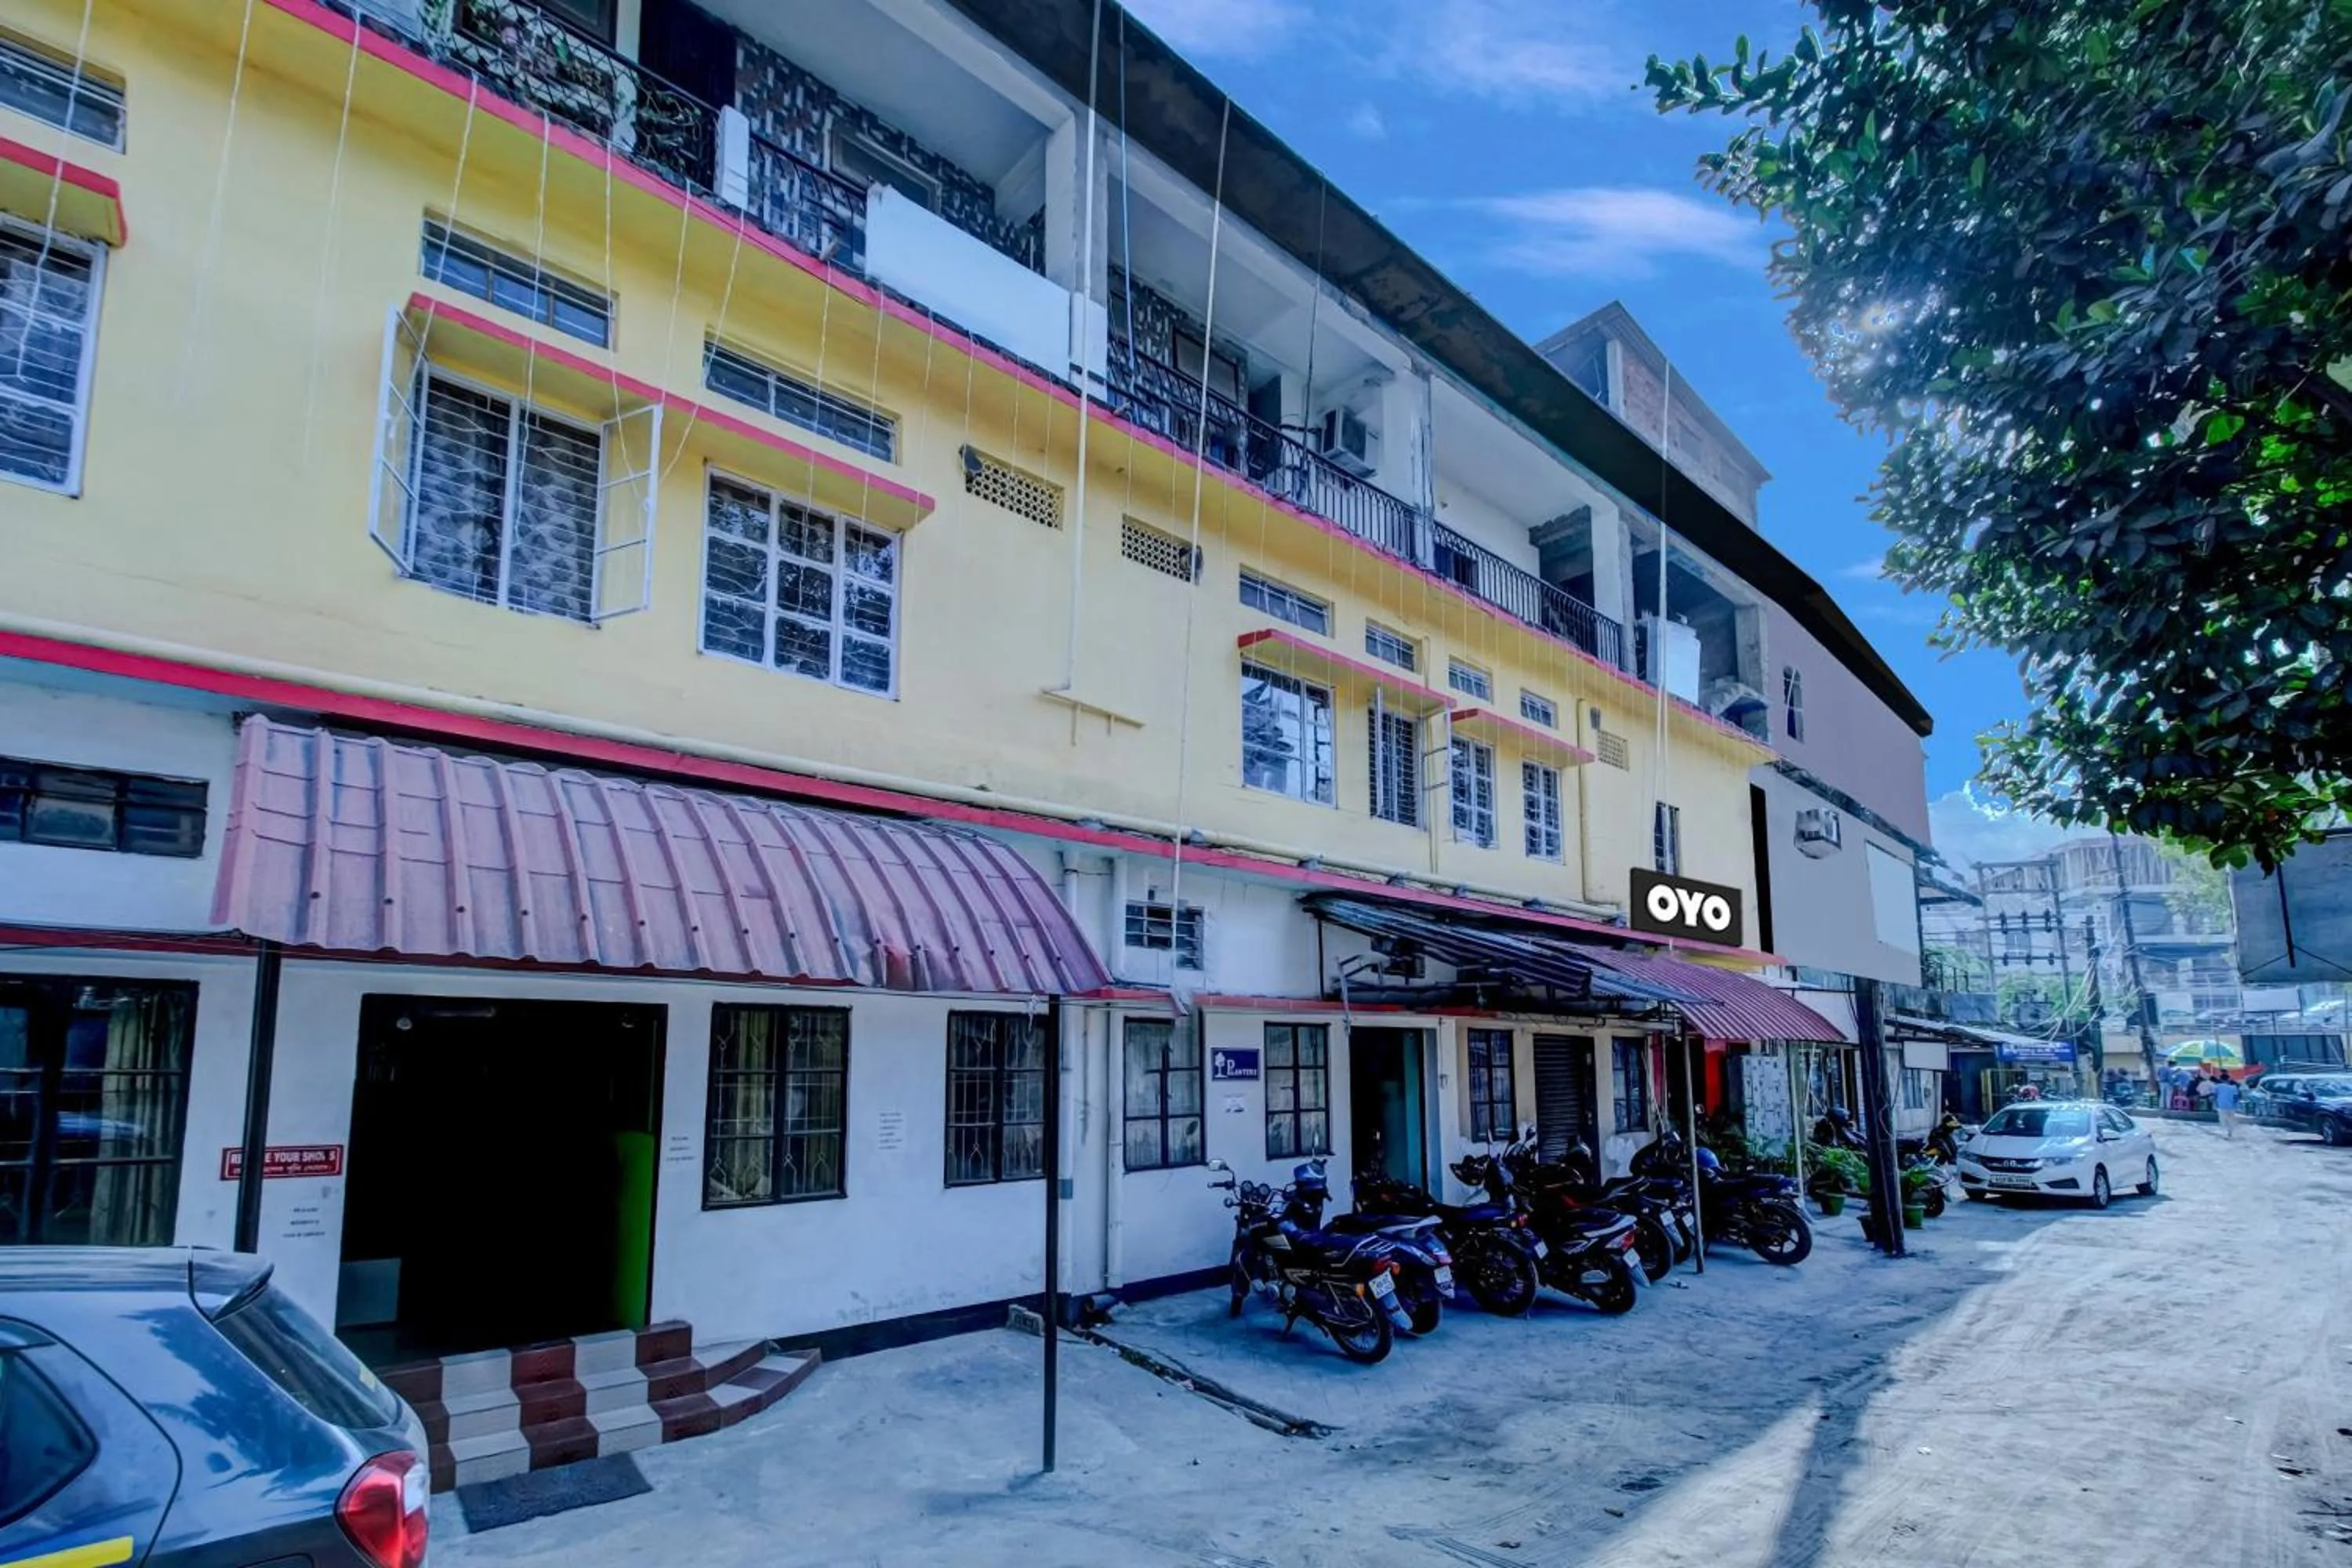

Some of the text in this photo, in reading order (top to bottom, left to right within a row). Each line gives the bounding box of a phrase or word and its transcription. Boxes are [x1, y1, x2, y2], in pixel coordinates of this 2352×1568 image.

[1647, 884, 1732, 931] OYO
[230, 1152, 272, 1164] REE
[274, 1152, 300, 1163] YOUR
